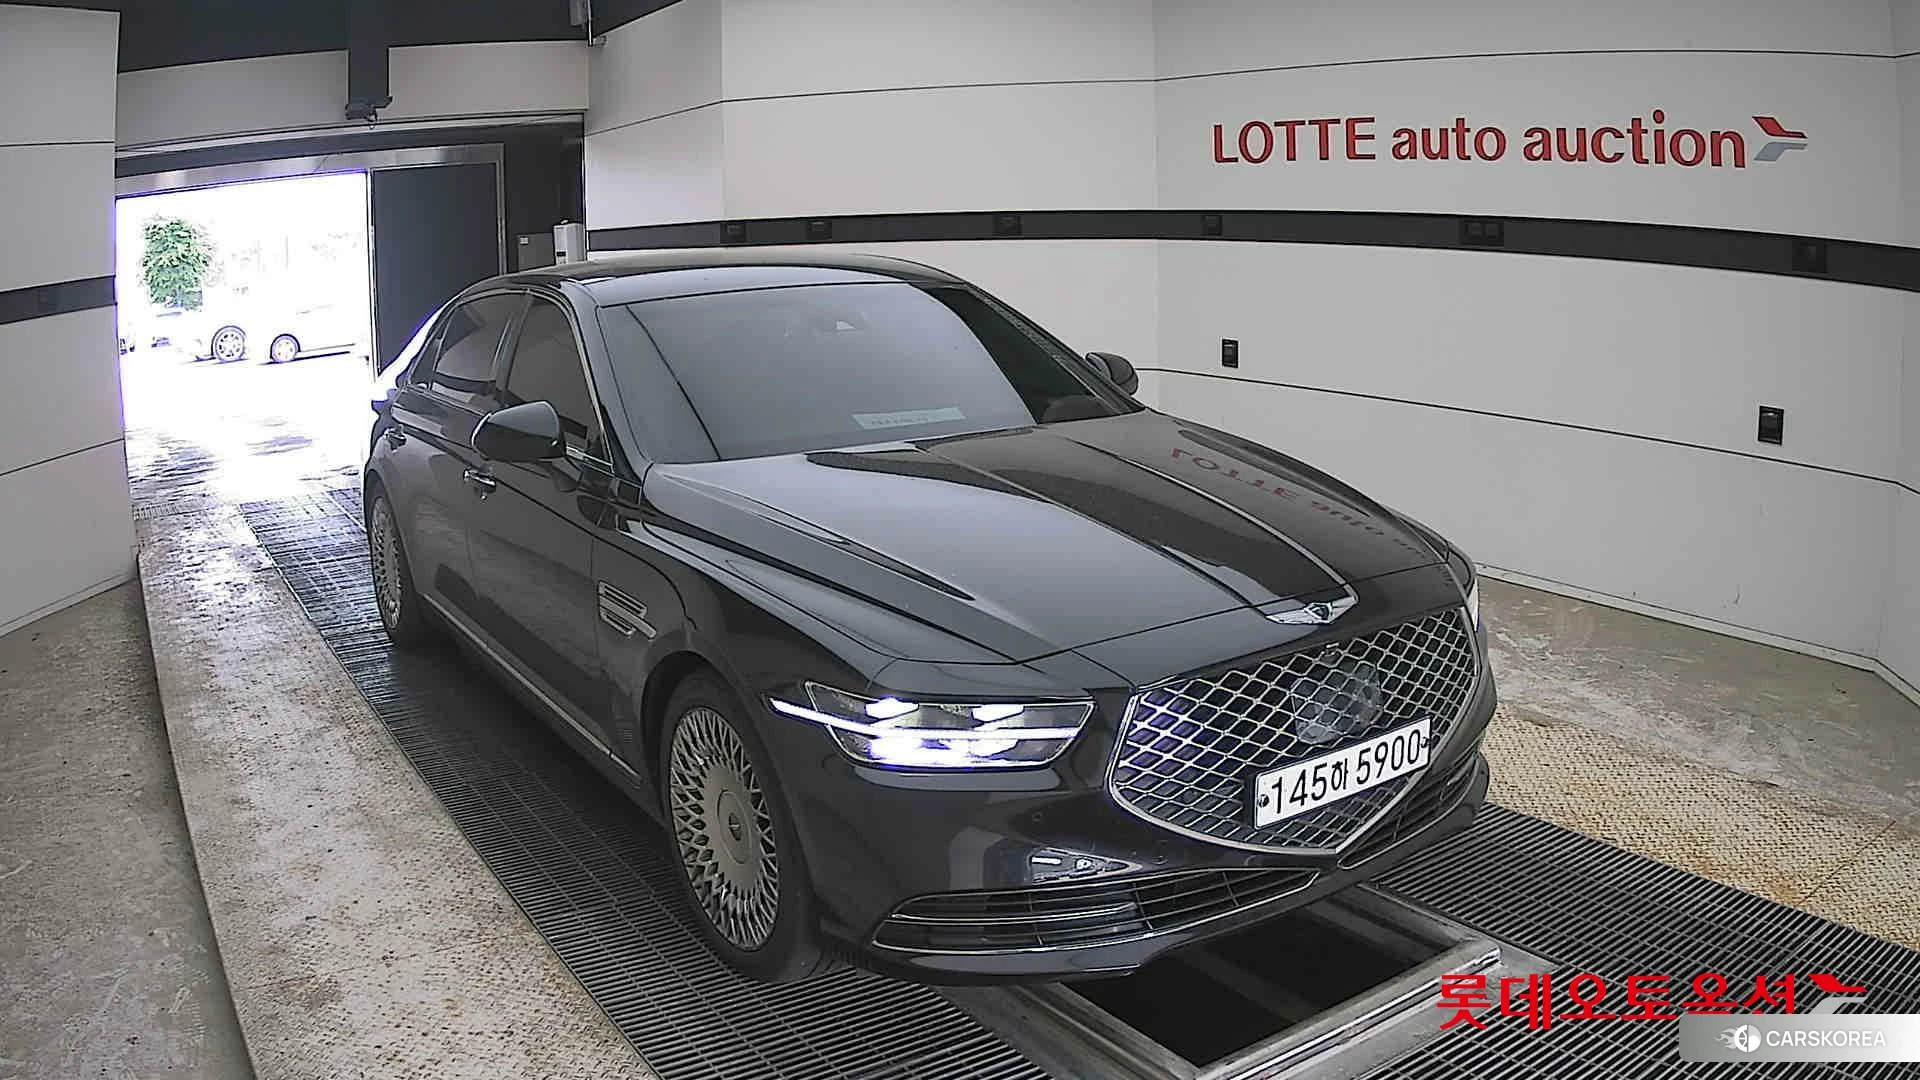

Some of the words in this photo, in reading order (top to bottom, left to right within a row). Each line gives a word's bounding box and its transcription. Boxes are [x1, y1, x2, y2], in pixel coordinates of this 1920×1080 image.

[1213, 117, 1375, 164] LOTTE
[1391, 117, 1507, 161] auto
[1523, 109, 1746, 168] auction
[1271, 757, 1349, 815] 145하
[1356, 729, 1421, 785] 5900
